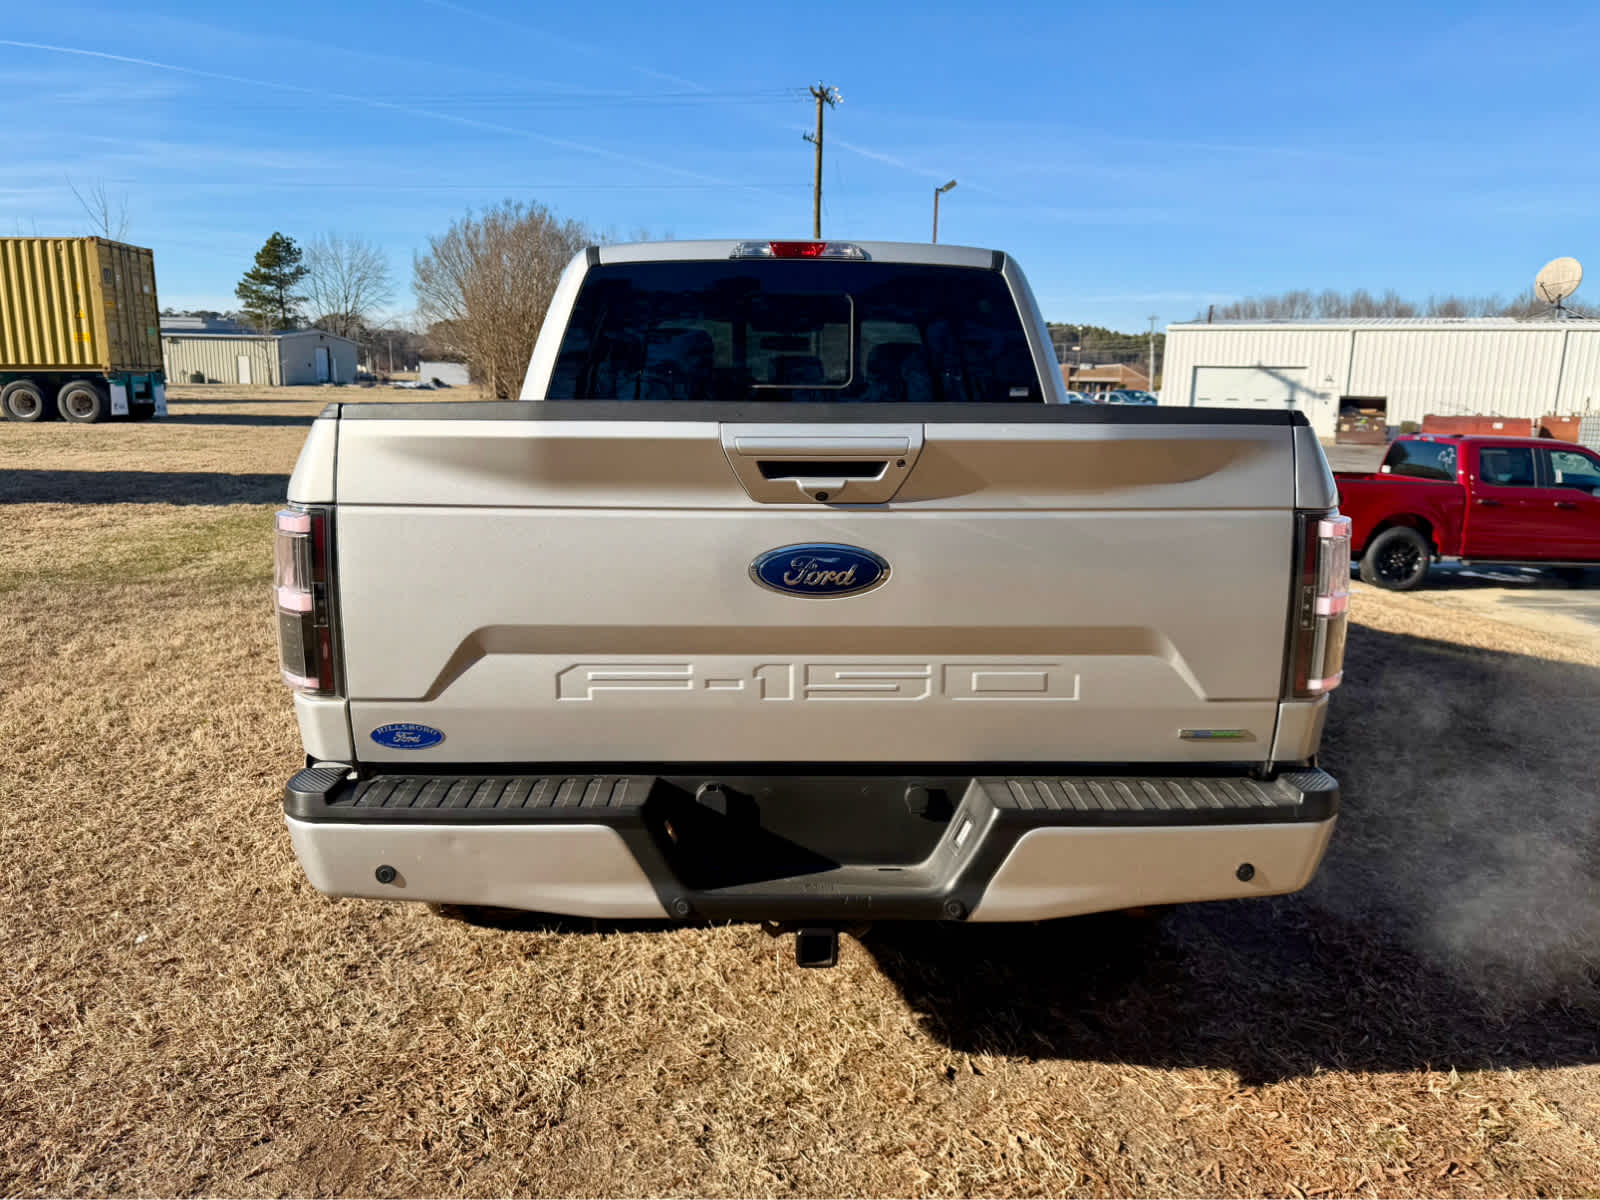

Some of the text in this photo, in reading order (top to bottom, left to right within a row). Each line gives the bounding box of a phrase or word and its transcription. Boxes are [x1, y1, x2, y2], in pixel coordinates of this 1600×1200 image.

[783, 555, 858, 587] Ford
[555, 663, 1081, 701] F-150
[393, 731, 421, 743] Ford
